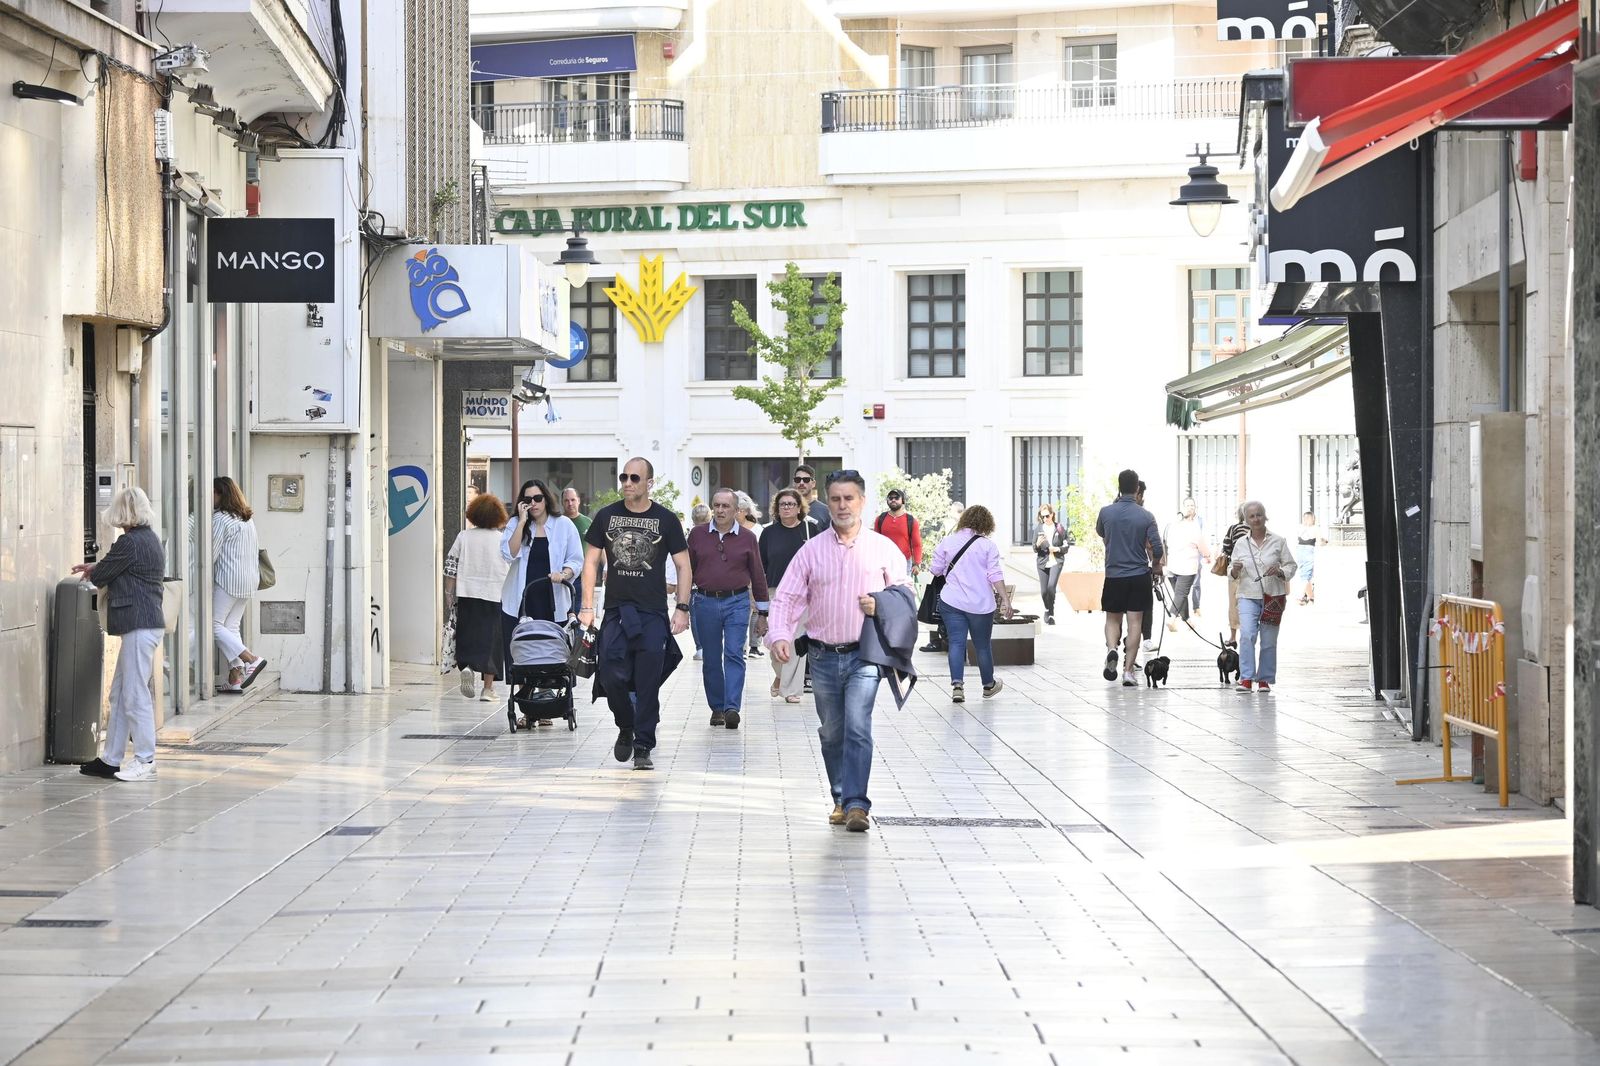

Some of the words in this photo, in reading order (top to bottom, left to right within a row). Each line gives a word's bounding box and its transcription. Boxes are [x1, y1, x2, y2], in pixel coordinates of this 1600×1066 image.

[585, 56, 609, 65] Seguros
[494, 208, 564, 237] CAJA
[571, 205, 673, 233] RURAL
[677, 203, 739, 231] DEL
[743, 201, 808, 229] SUR
[217, 251, 325, 270] MANGO
[466, 397, 508, 406] MUNDO
[652, 439, 660, 451] 2
[608, 515, 660, 535] BERSERKER
